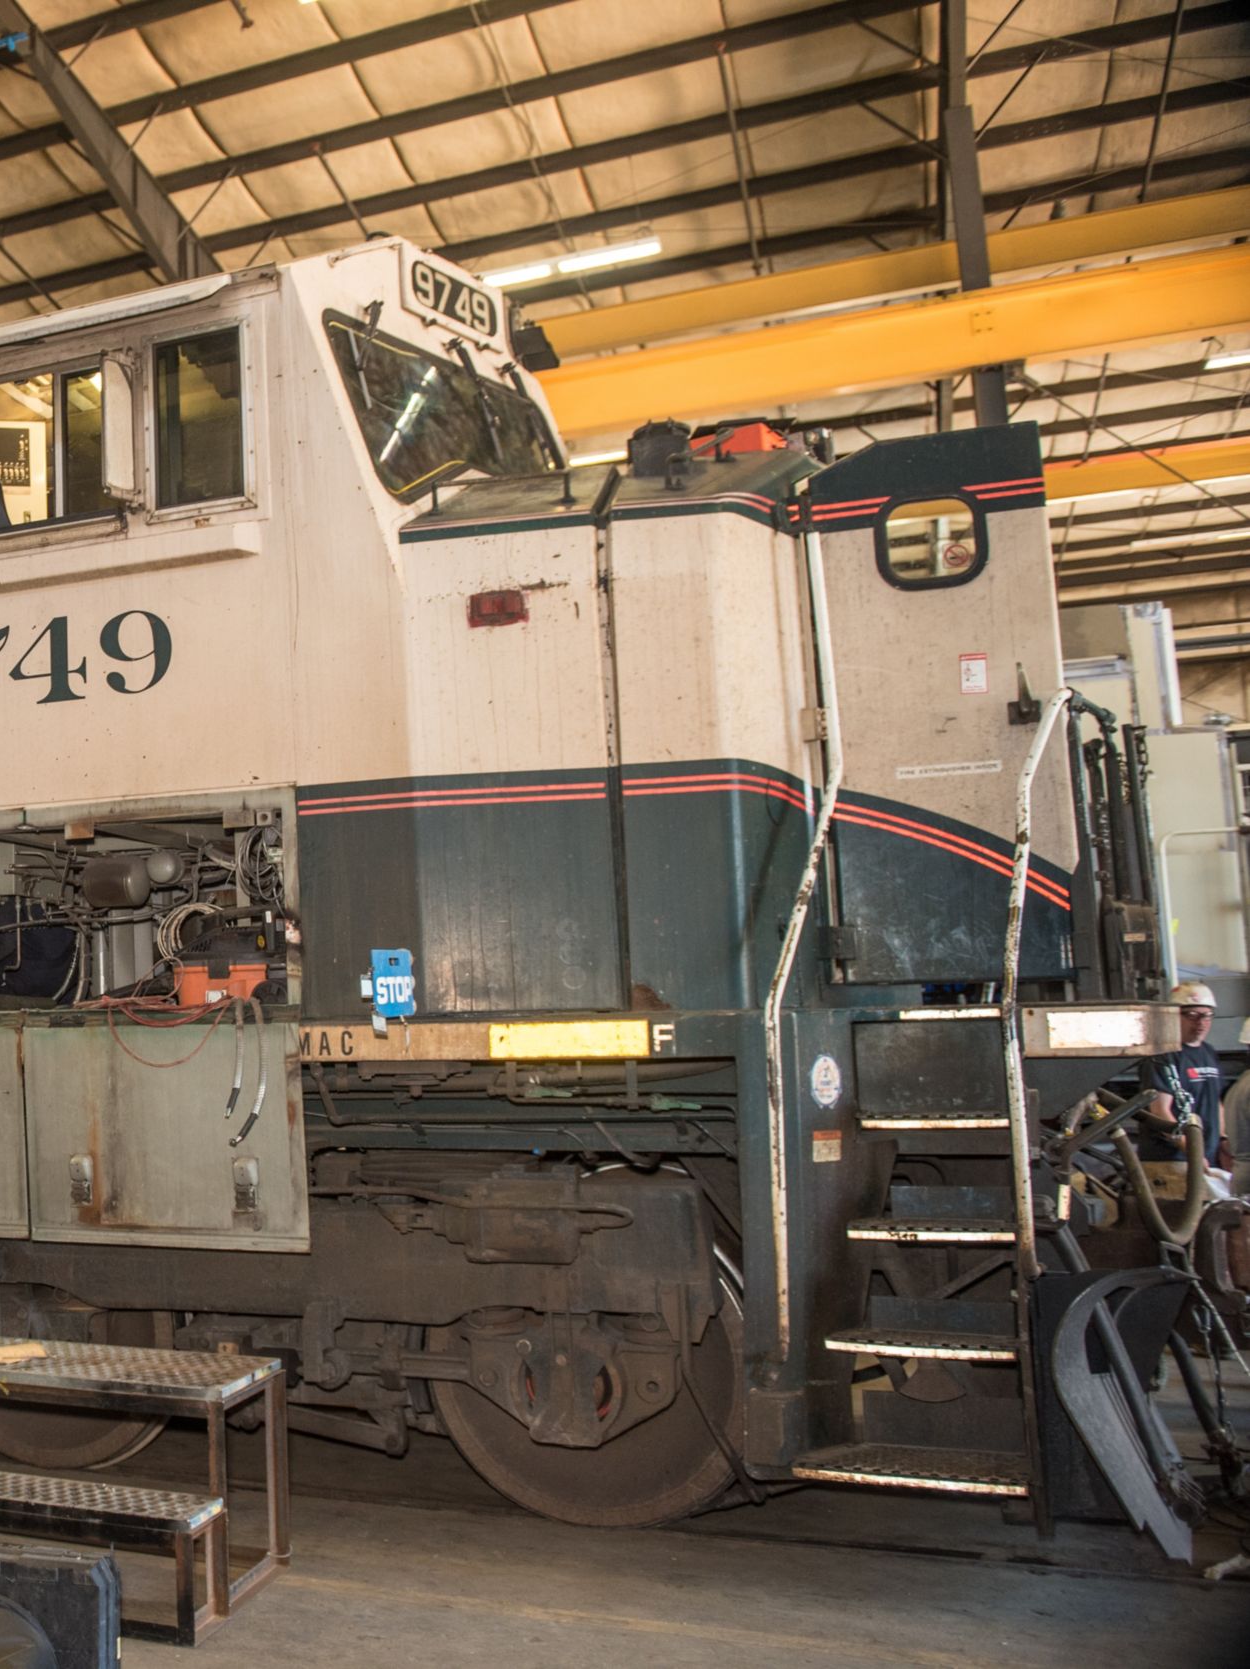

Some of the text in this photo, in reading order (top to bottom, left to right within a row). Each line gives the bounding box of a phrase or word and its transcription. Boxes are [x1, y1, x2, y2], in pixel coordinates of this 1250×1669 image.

[414, 263, 492, 334] 9749
[376, 975, 413, 1005] STOP
[652, 1023, 675, 1052] F
